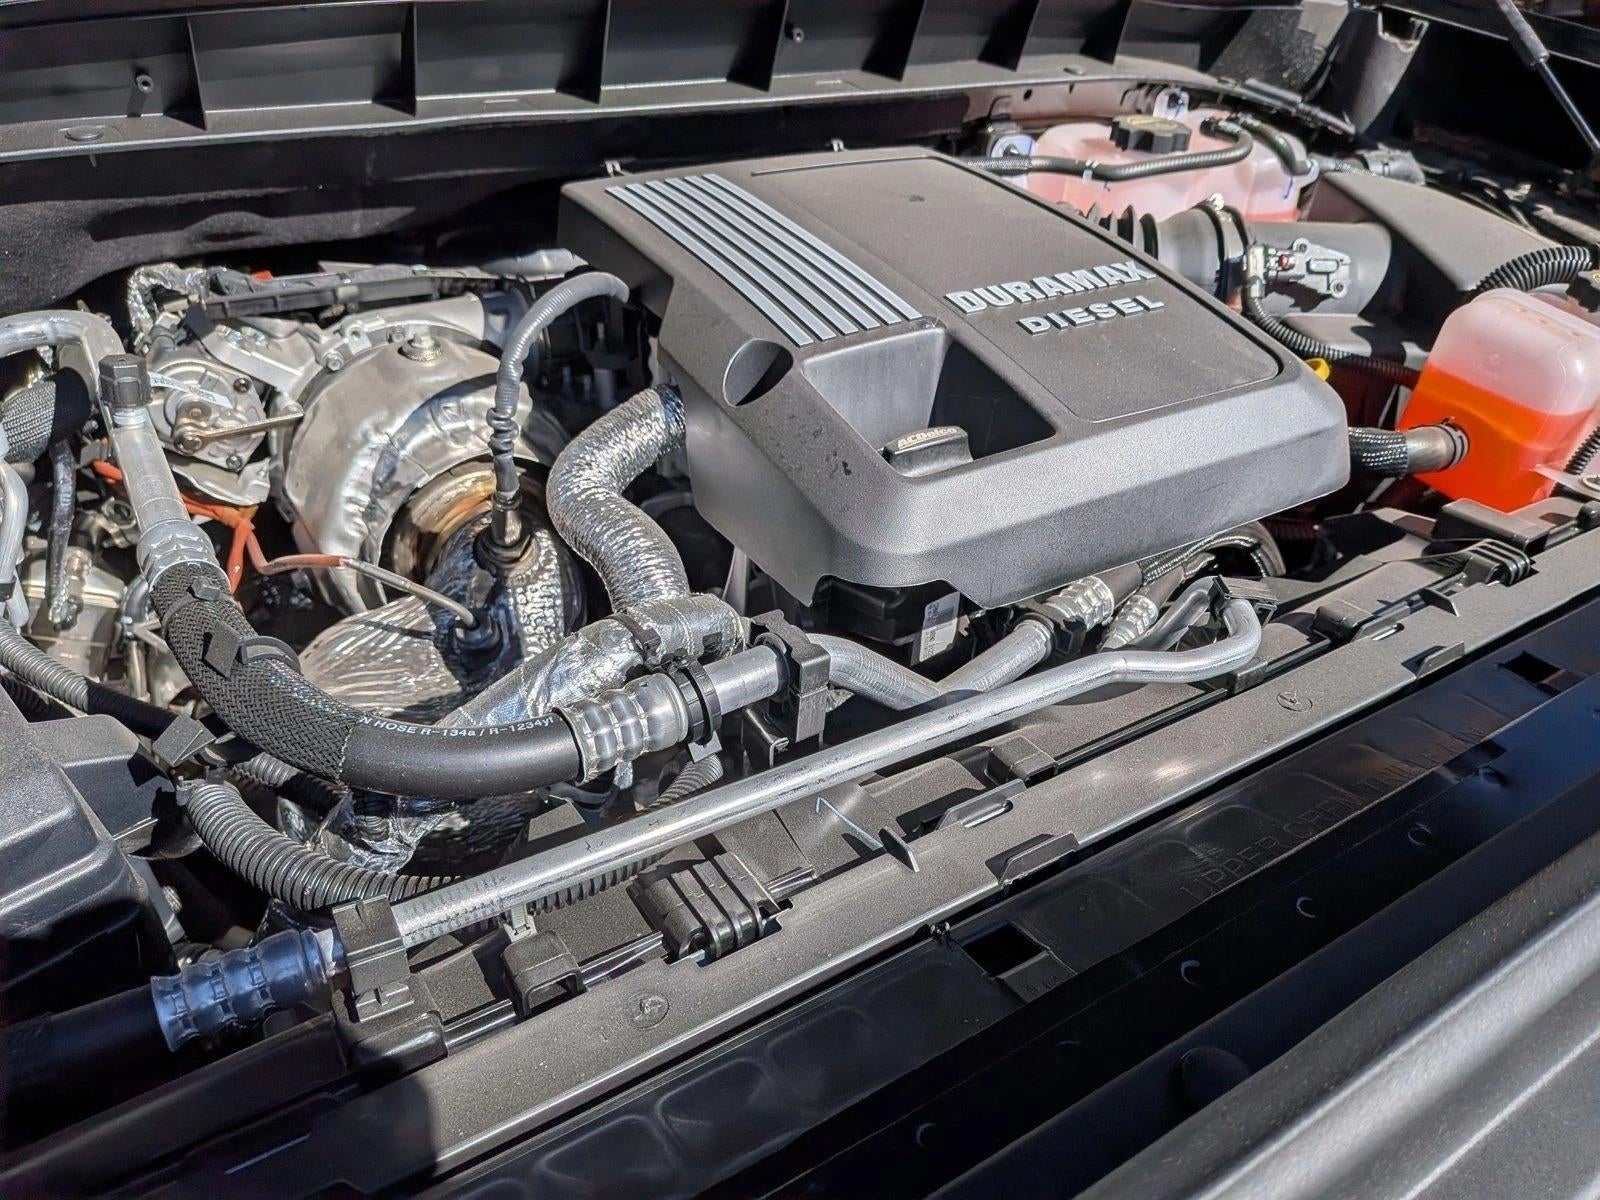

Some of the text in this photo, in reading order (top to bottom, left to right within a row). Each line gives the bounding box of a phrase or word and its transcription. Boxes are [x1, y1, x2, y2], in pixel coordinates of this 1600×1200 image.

[943, 260, 1157, 315] DURAMAX
[1016, 294, 1164, 336] DIESEL
[374, 720, 418, 734] HOSE
[420, 727, 476, 737] R-134a
